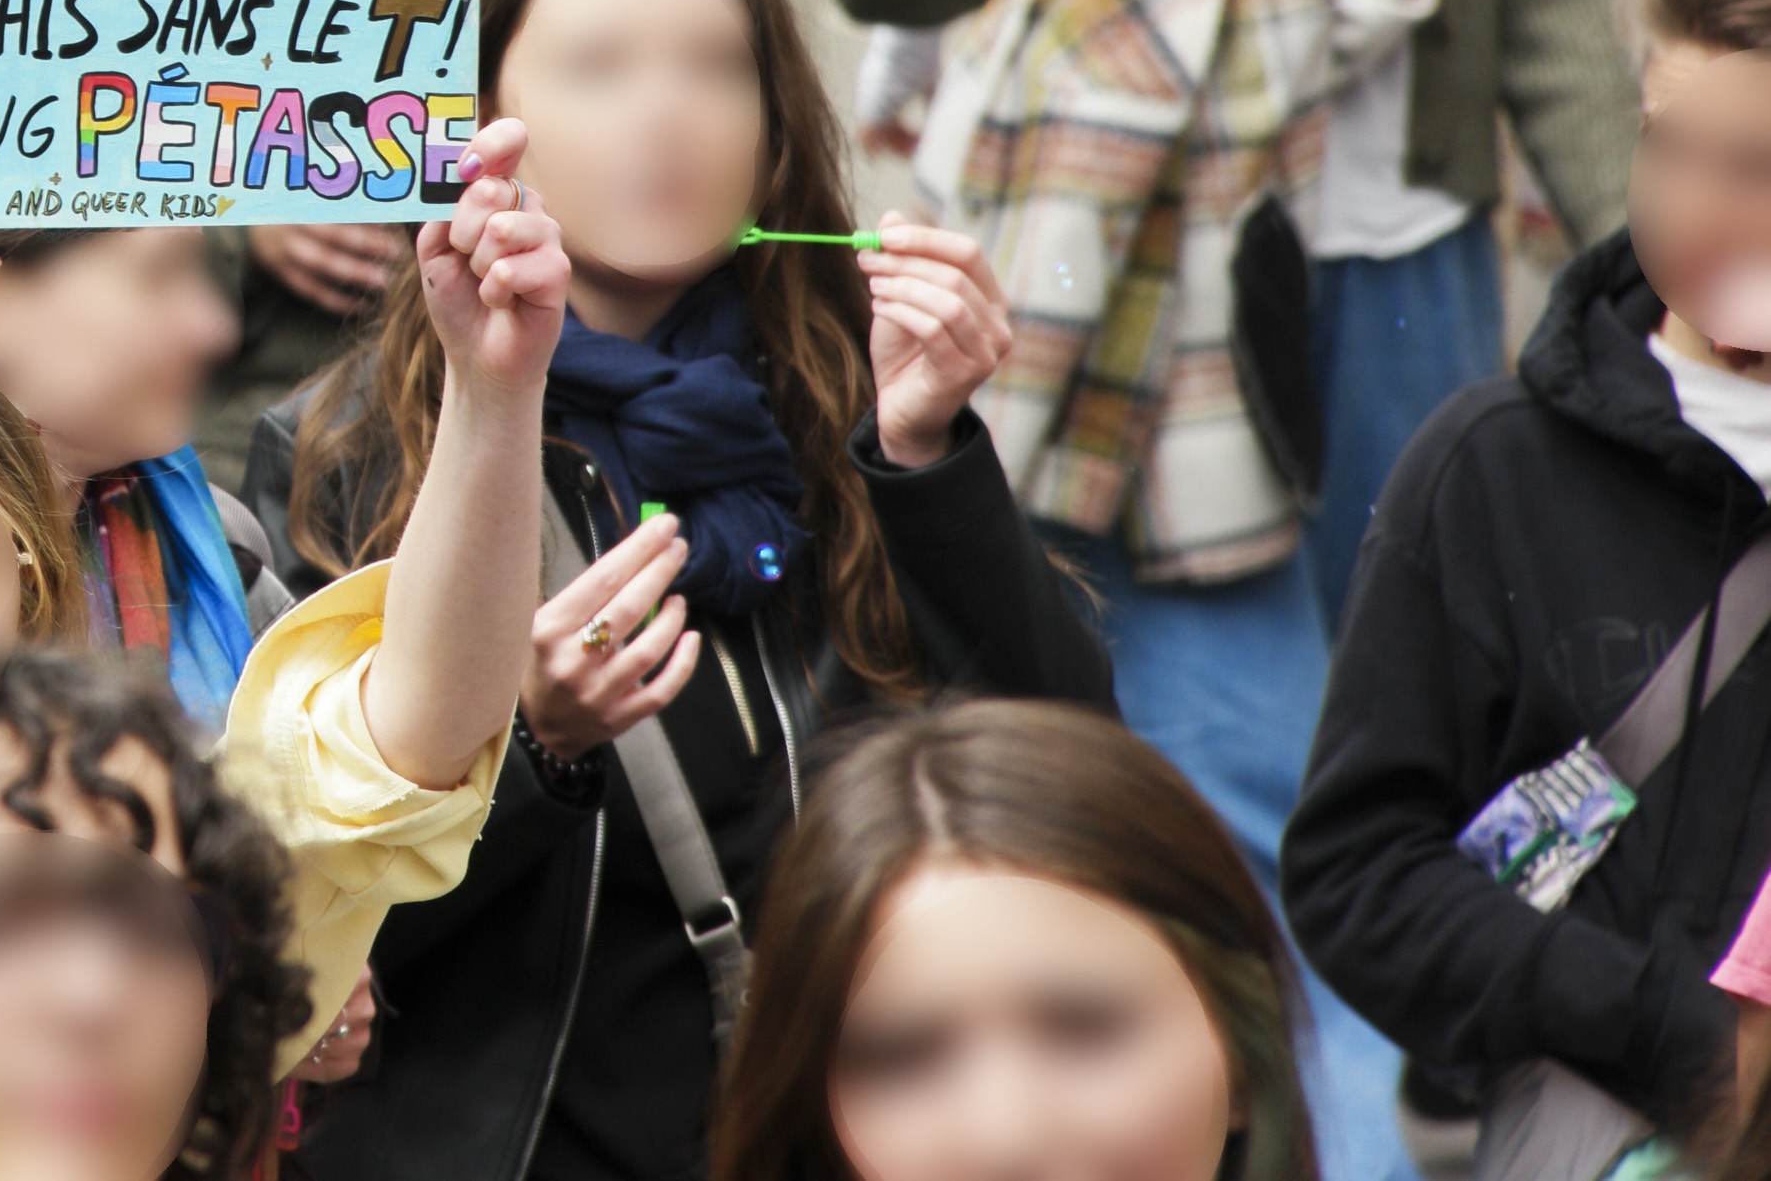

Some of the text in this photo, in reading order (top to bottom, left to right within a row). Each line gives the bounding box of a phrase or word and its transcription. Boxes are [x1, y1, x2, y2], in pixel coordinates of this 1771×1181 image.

[76, 61, 477, 205] PÉTASSE
[5, 188, 63, 219] AND
[71, 190, 150, 221] QUEER
[160, 191, 218, 220] KIDS
